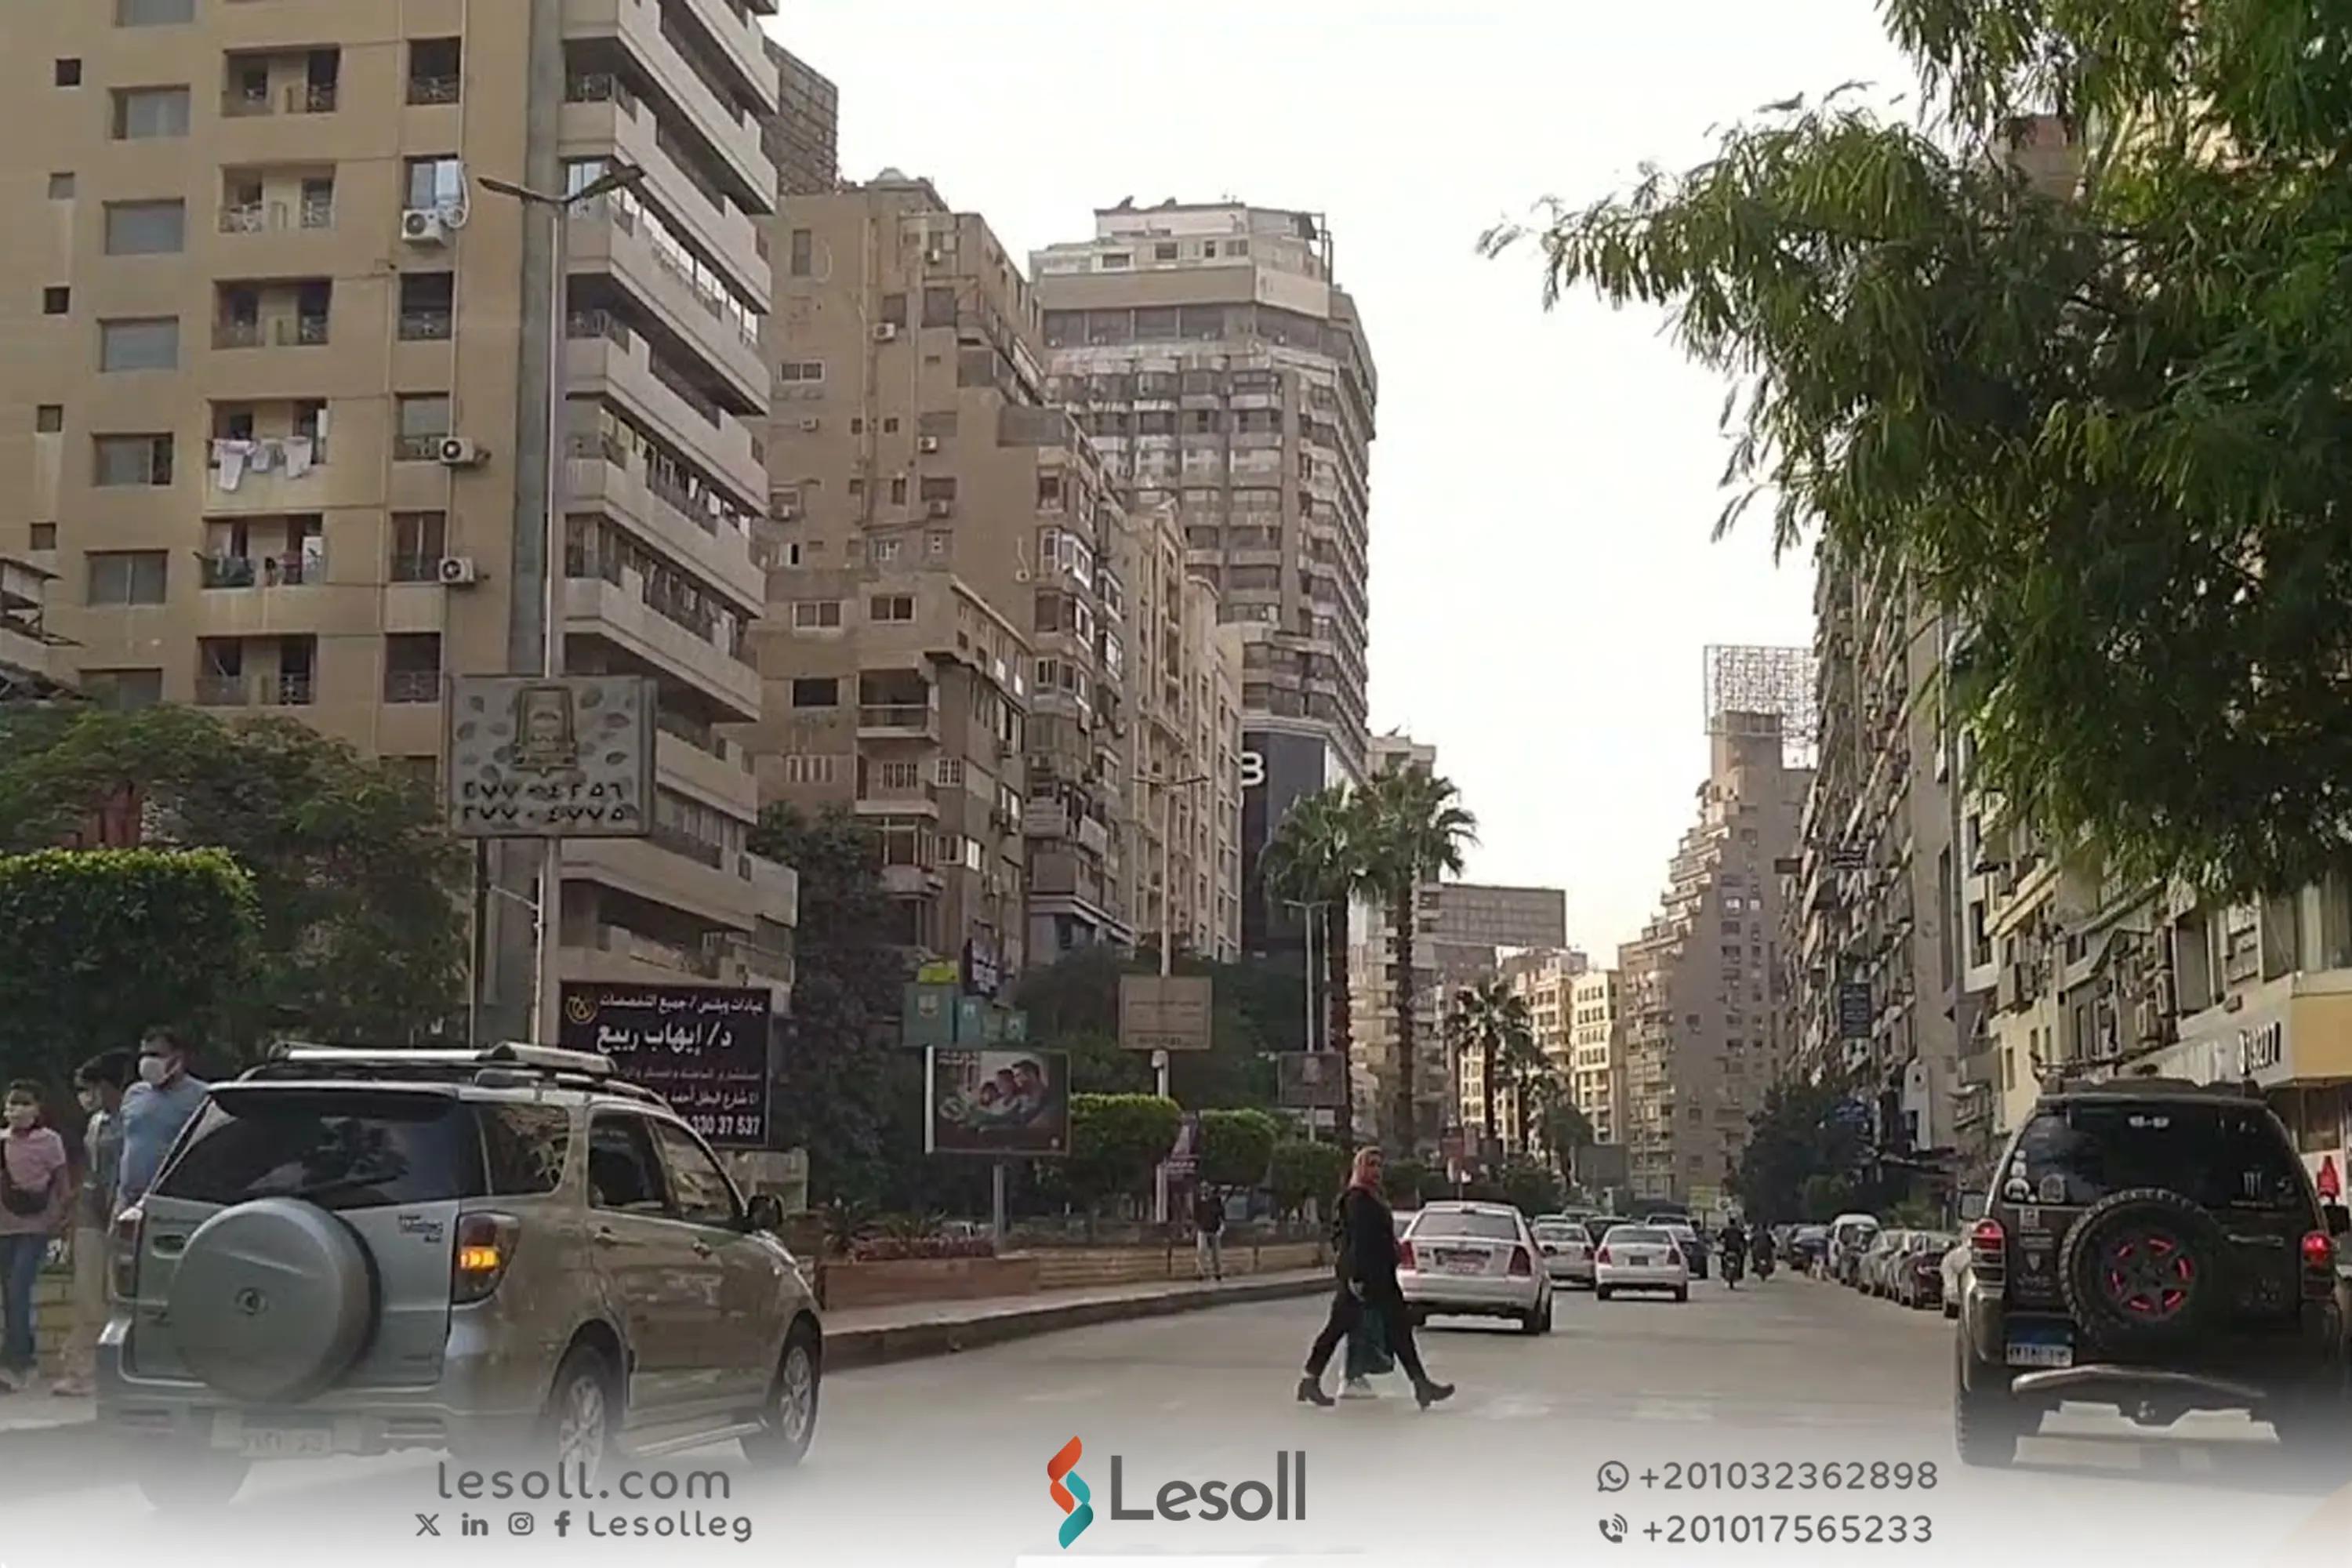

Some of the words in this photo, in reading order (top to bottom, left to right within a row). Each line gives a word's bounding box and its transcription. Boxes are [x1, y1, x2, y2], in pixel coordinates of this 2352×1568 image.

[658, 996, 686, 1014] جميع
[597, 1024, 639, 1054] ربيع
[644, 1021, 702, 1055] إيهاب
